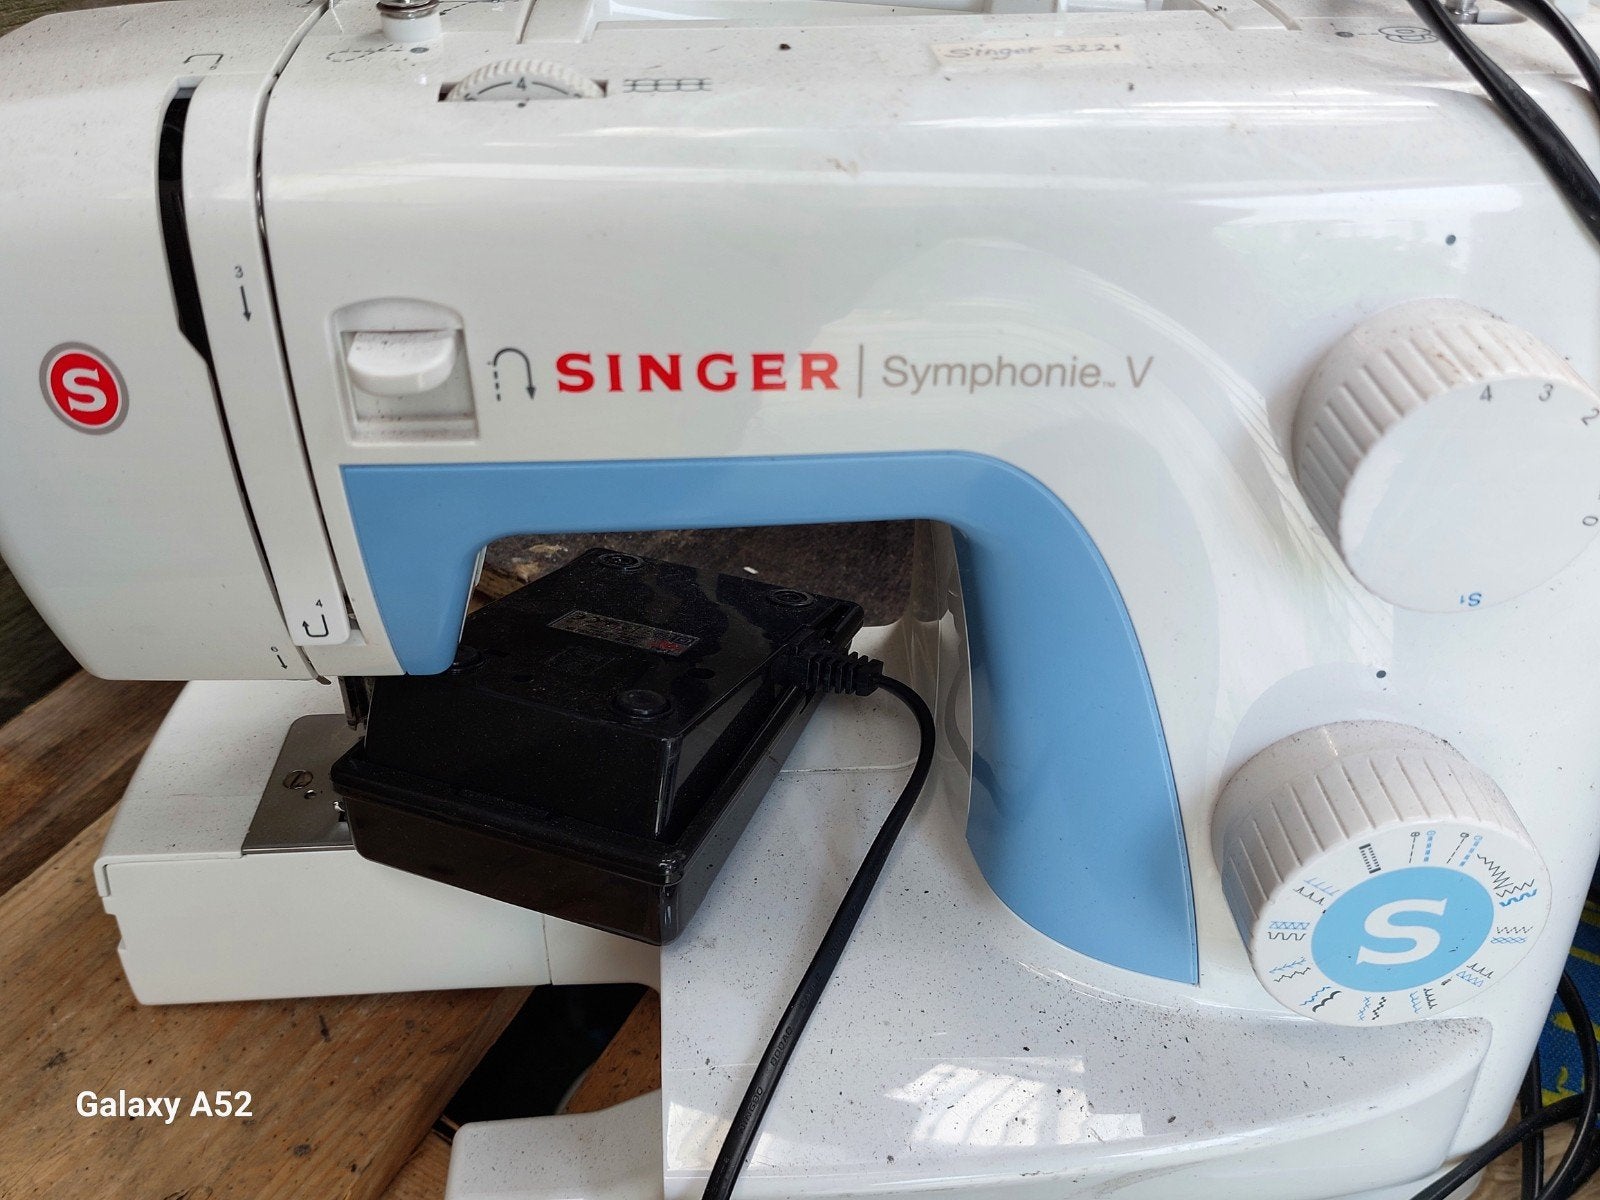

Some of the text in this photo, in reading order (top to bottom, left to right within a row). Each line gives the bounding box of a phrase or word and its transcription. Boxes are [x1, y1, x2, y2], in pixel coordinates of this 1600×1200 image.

[943, 44, 1041, 60] Singer
[516, 77, 527, 91] 4
[234, 265, 244, 279] 3
[556, 352, 840, 394] SINGER
[1126, 354, 1154, 389] V
[62, 367, 107, 413] S
[1479, 384, 1493, 402] 4
[1538, 383, 1554, 402] 3
[1581, 408, 1600, 426] 2
[1582, 515, 1599, 527] 0
[1355, 897, 1448, 966] S
